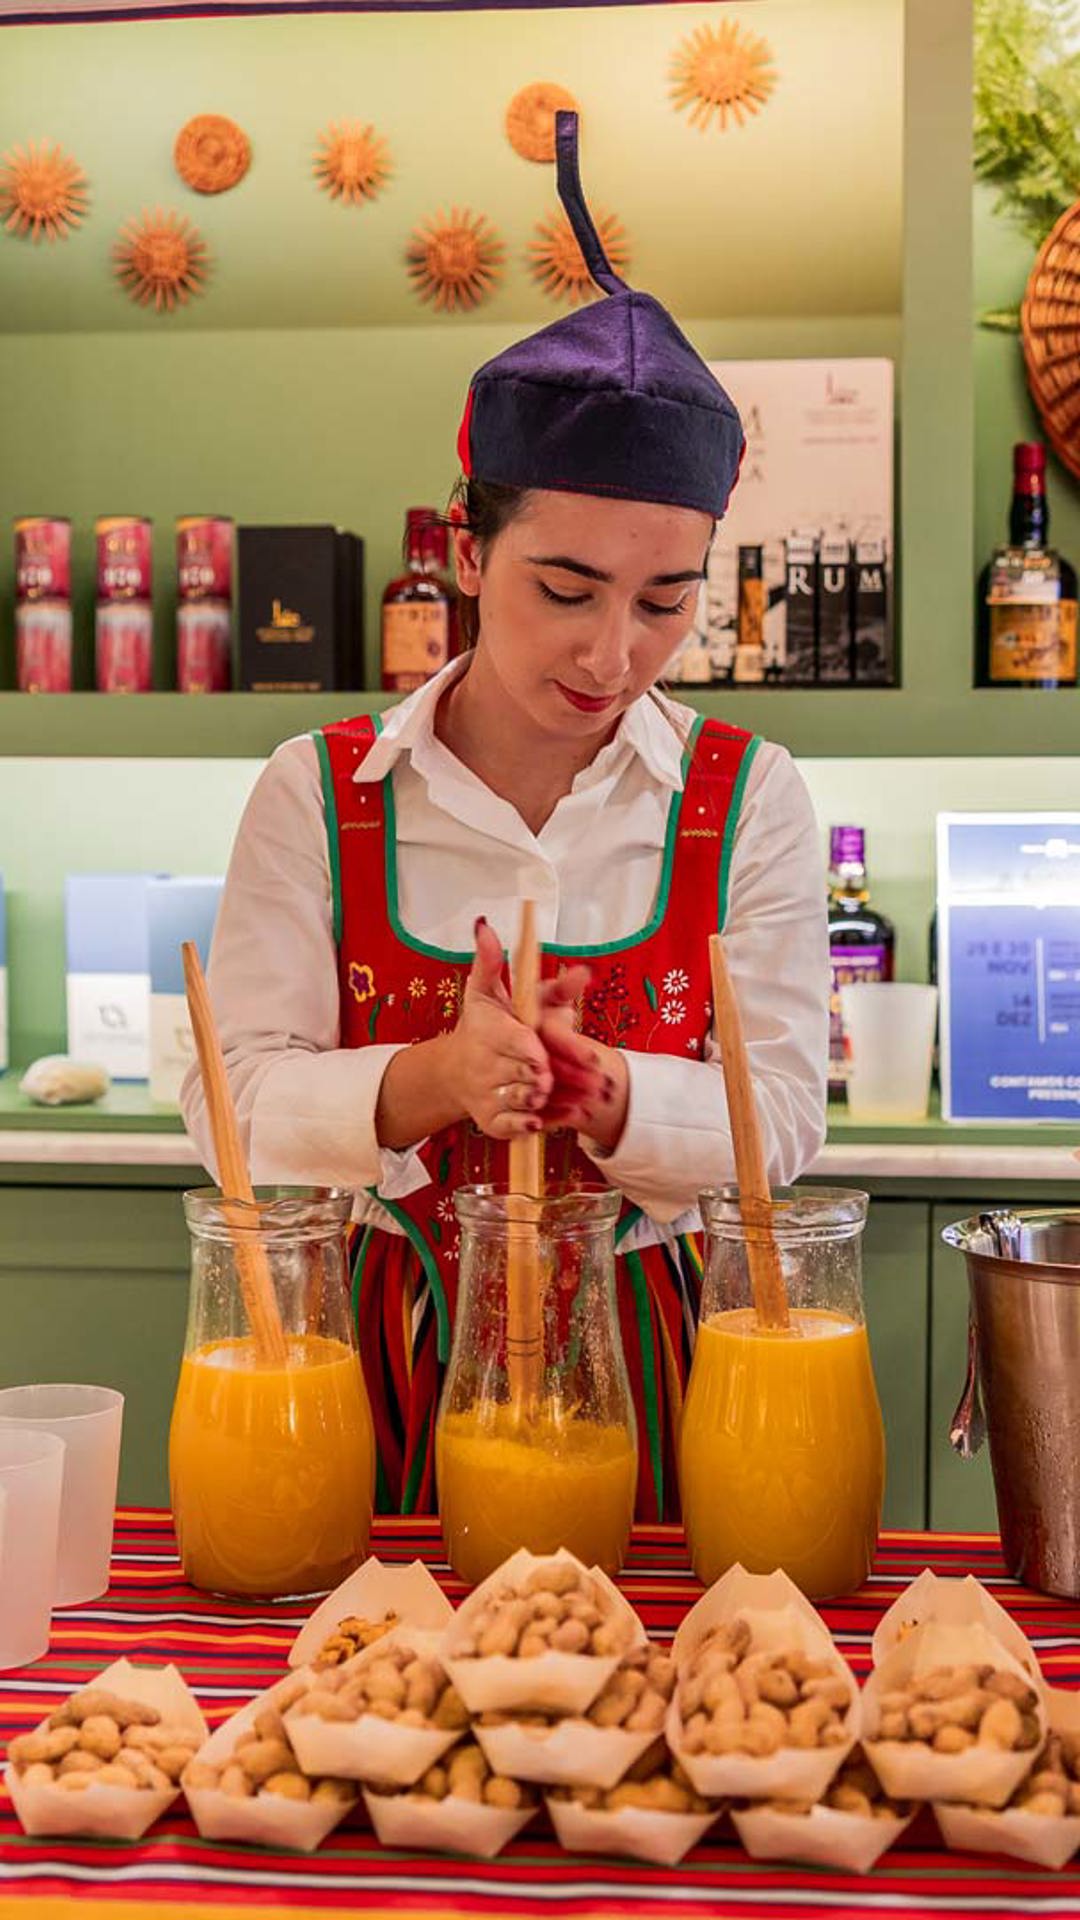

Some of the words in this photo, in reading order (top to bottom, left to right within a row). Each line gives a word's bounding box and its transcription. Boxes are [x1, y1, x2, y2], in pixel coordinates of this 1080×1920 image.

[788, 566, 883, 594] RUM
[987, 961, 1031, 974] NOV
[1013, 994, 1031, 1007] 14
[996, 1011, 1032, 1026] DEZ
[990, 1075, 1063, 1088] CONTAMOS
